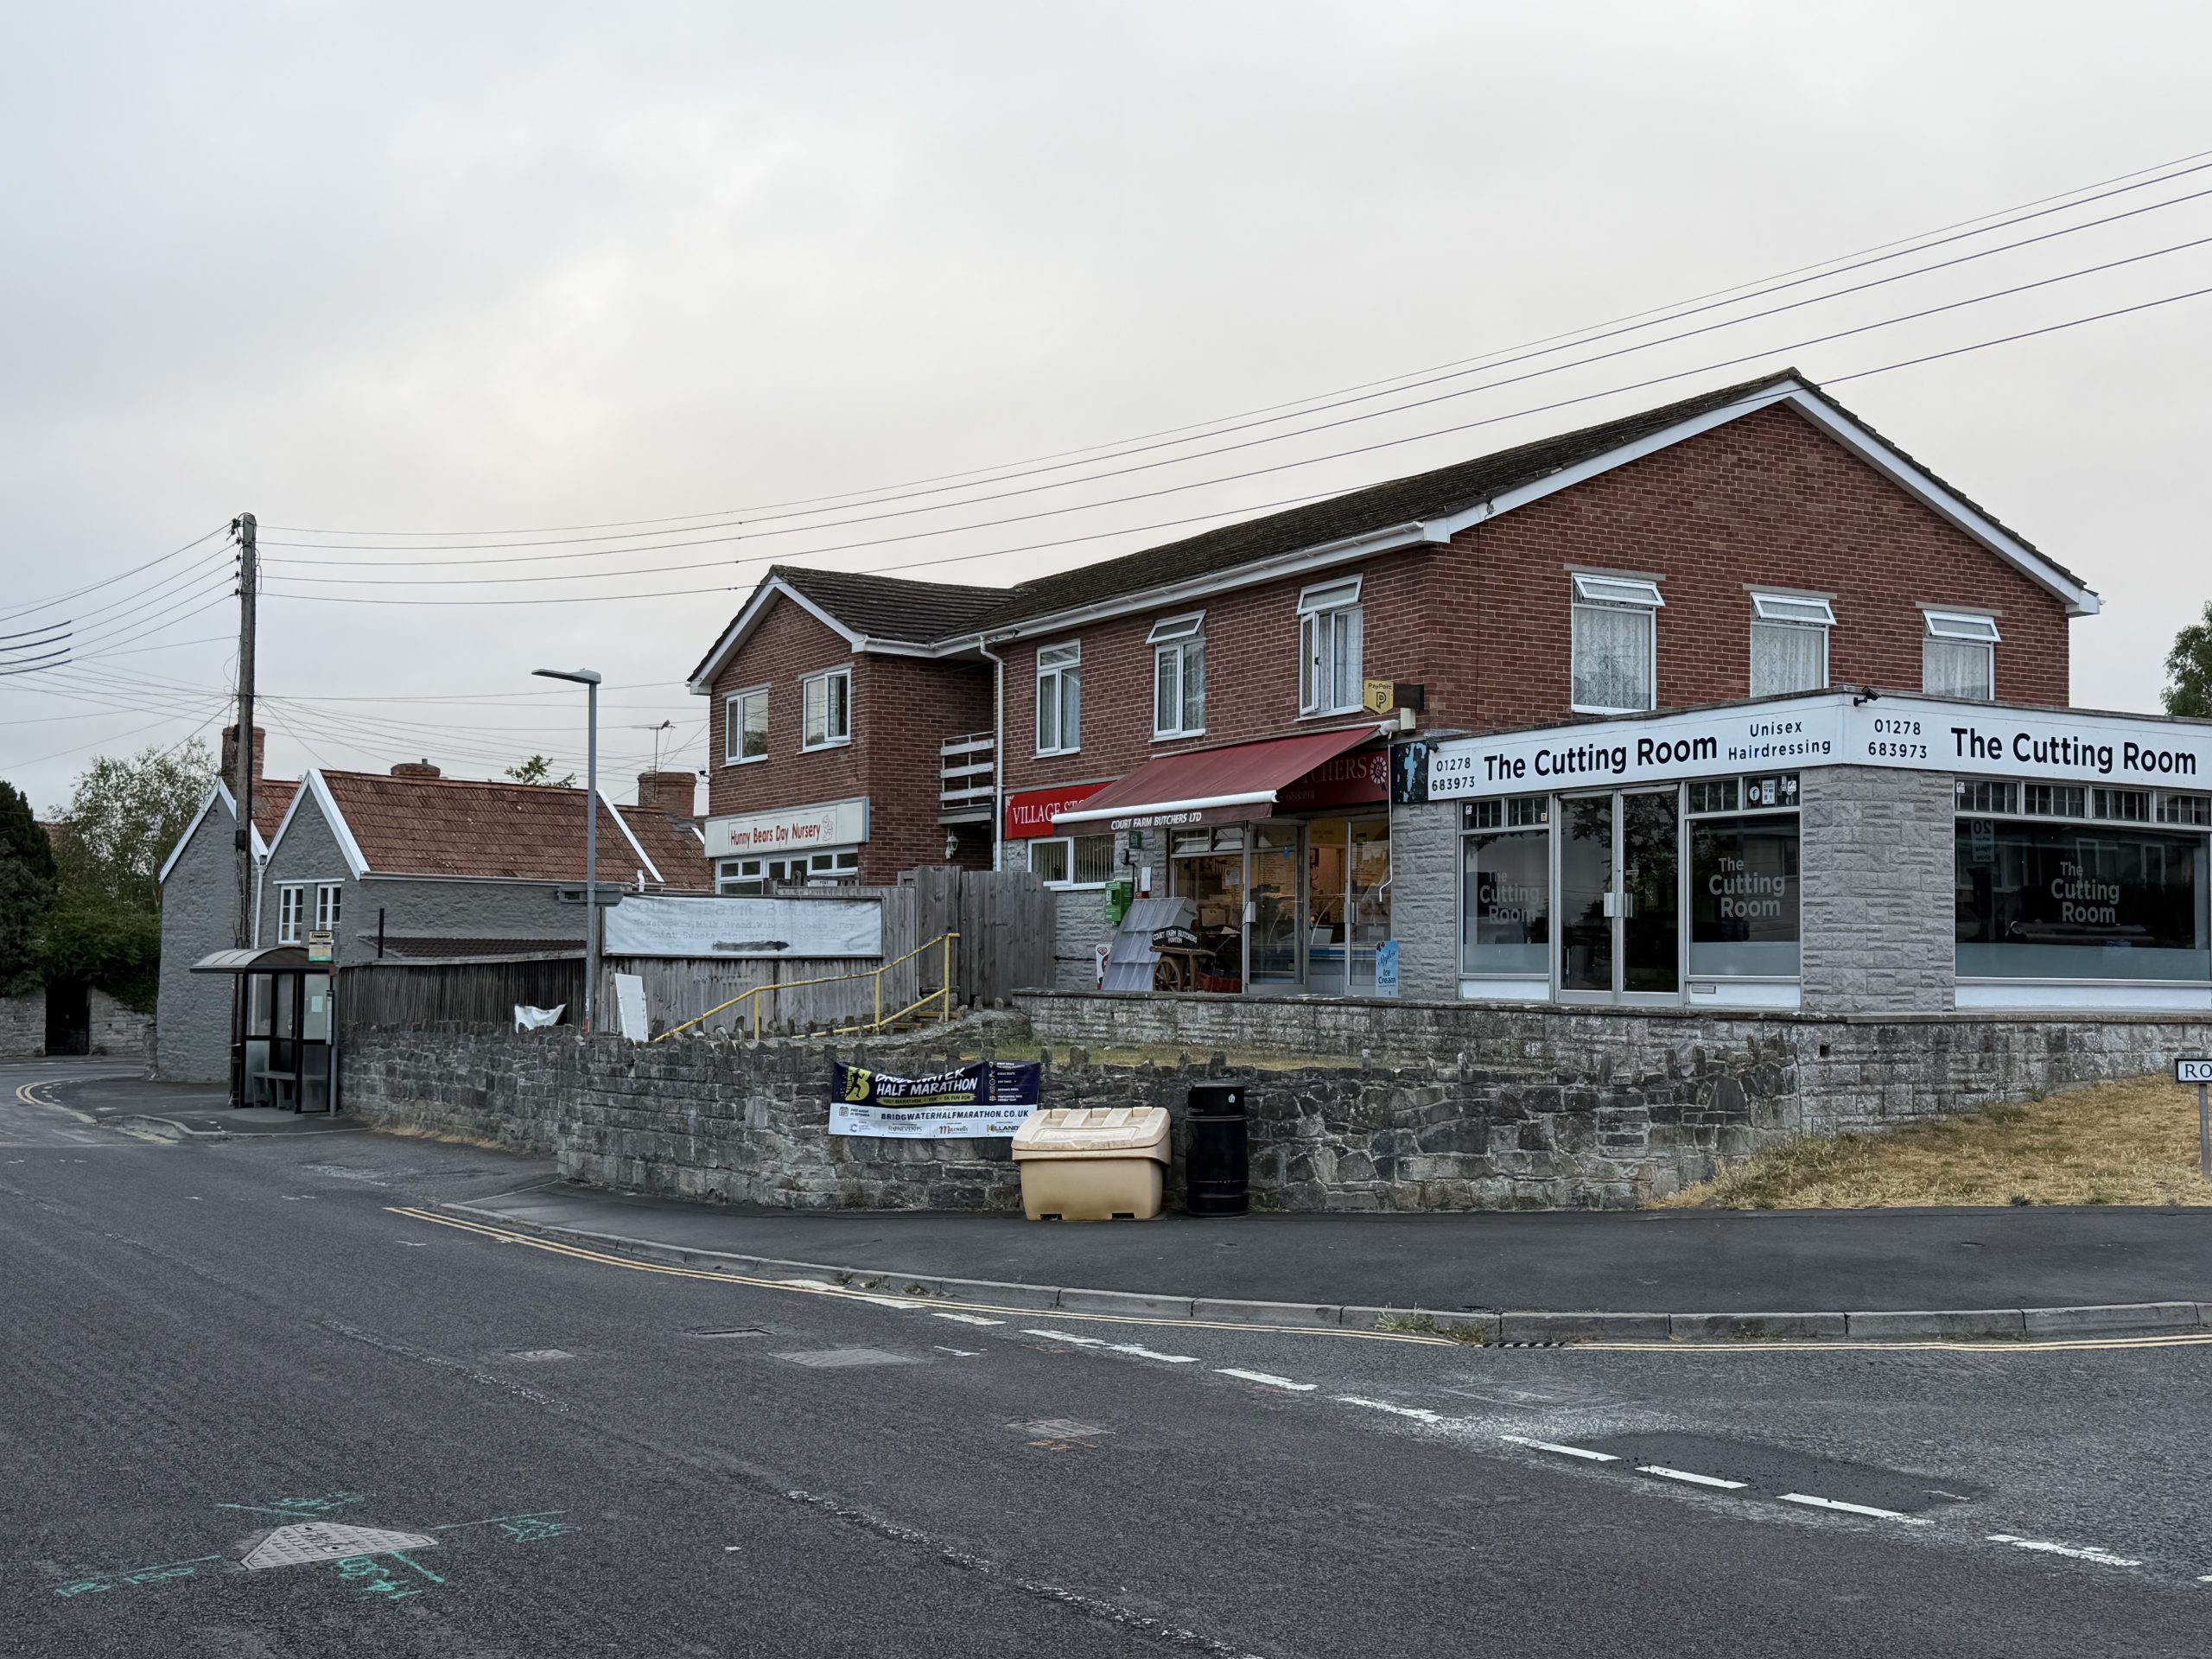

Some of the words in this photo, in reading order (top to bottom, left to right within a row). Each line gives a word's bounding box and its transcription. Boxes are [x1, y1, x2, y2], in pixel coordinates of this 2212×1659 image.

[1750, 721, 1802, 737] Unisex
[1874, 719, 1921, 735] 01278
[1484, 753, 1527, 781] The
[1535, 743, 1627, 774] Cutting
[1637, 736, 1718, 766] Room
[1728, 739, 1831, 760] Hairdressing
[1868, 741, 1928, 759] 683973
[1950, 728, 2003, 760] The
[2012, 733, 2113, 774] Cutting
[2123, 742, 2196, 775] Room
[1436, 757, 1471, 772] 01278
[1431, 776, 1475, 791] 683973
[1012, 802, 1061, 824] VILLAGE
[1110, 818, 1131, 830] COURT
[1133, 818, 1152, 828] FARM
[1154, 814, 1187, 826] BUTCHERS
[1189, 812, 1202, 823] LTD
[730, 830, 751, 849] Hunny
[753, 827, 773, 844] Bears
[776, 824, 789, 846] Day
[792, 823, 821, 842] Nursery
[1718, 857, 1745, 872] The
[2059, 861, 2084, 876] The
[1487, 870, 1508, 883] The
[1709, 872, 1785, 897] Cutting
[1479, 883, 1540, 906] Cutting
[2050, 878, 2120, 905] Cutting
[1489, 905, 1536, 925] Room
[1721, 897, 1781, 918] Room
[2062, 901, 2116, 924] Room
[1153, 931, 1166, 941] COURT
[1166, 929, 1177, 938] FARM
[1178, 930, 1198, 944] BUTCHERS
[1377, 976, 1396, 985] Cream
[1382, 969, 1391, 977] Ice
[875, 1083, 906, 1096] HALF
[910, 1077, 978, 1096] MARATHON
[880, 1109, 1029, 1122] BRIDGWATERHALFMARATHON.CO.UK
